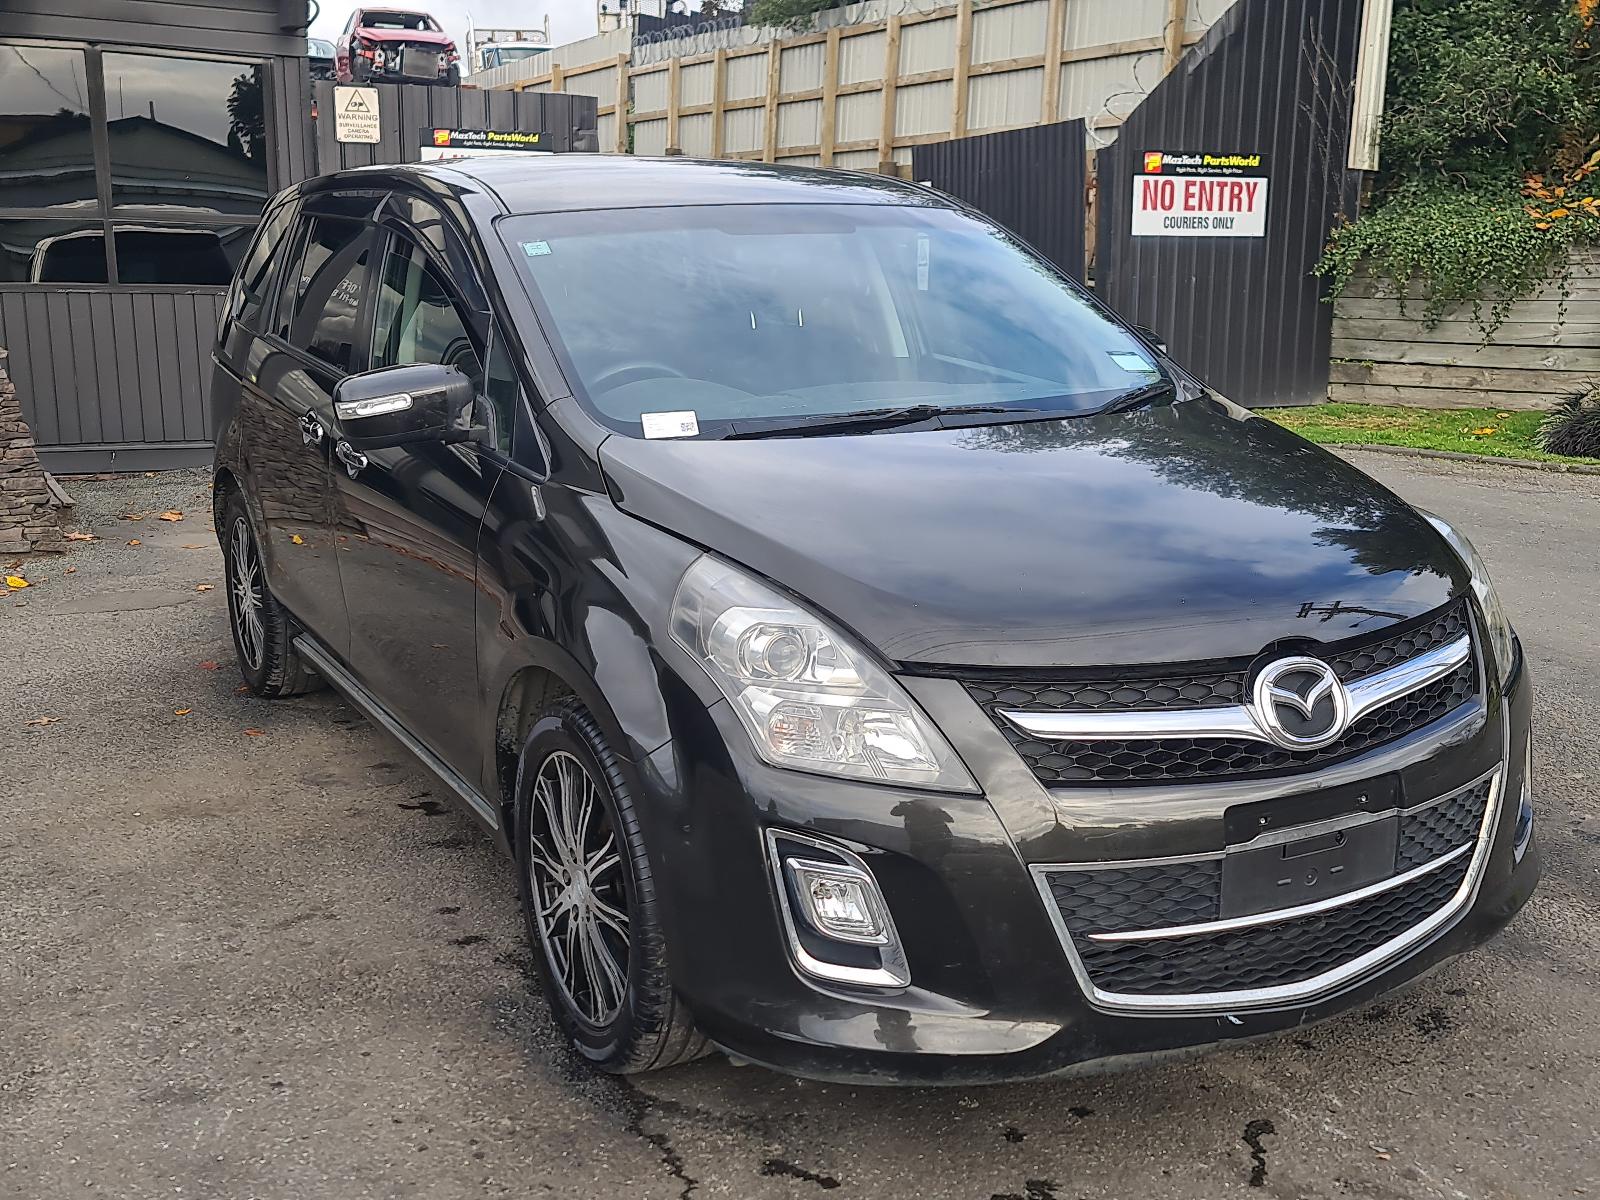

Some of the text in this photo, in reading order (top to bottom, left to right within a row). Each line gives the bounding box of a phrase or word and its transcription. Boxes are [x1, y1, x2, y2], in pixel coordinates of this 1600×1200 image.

[337, 112, 378, 121] WARNING
[487, 132, 539, 142] PartsWorld
[1203, 155, 1260, 167] PartsWorld
[1142, 179, 1258, 213] NO ENTRY
[1163, 216, 1235, 230] COURIERS ONLY
